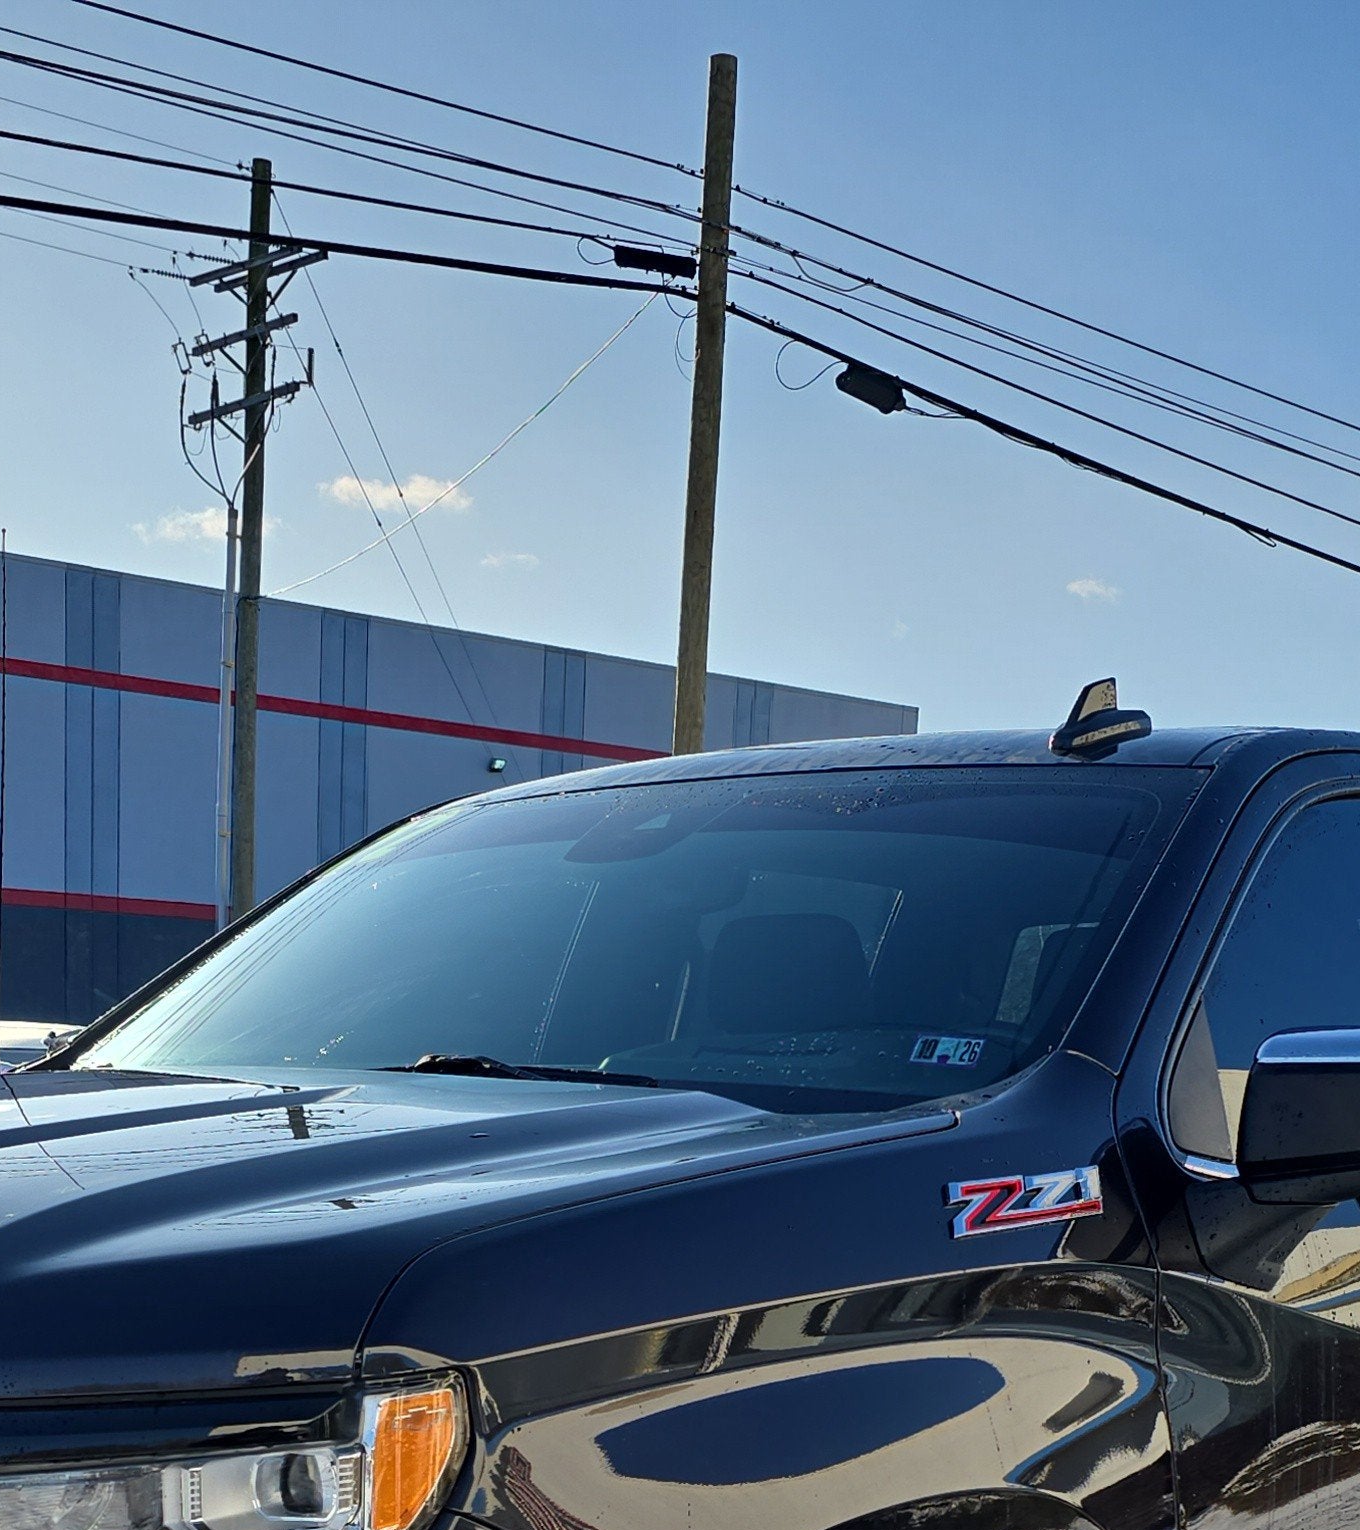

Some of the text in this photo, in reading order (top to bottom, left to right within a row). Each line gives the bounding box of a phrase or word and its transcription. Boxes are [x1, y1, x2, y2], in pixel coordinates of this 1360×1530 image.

[918, 1039, 981, 1062] 10 26
[943, 1165, 1103, 1239] Z71
